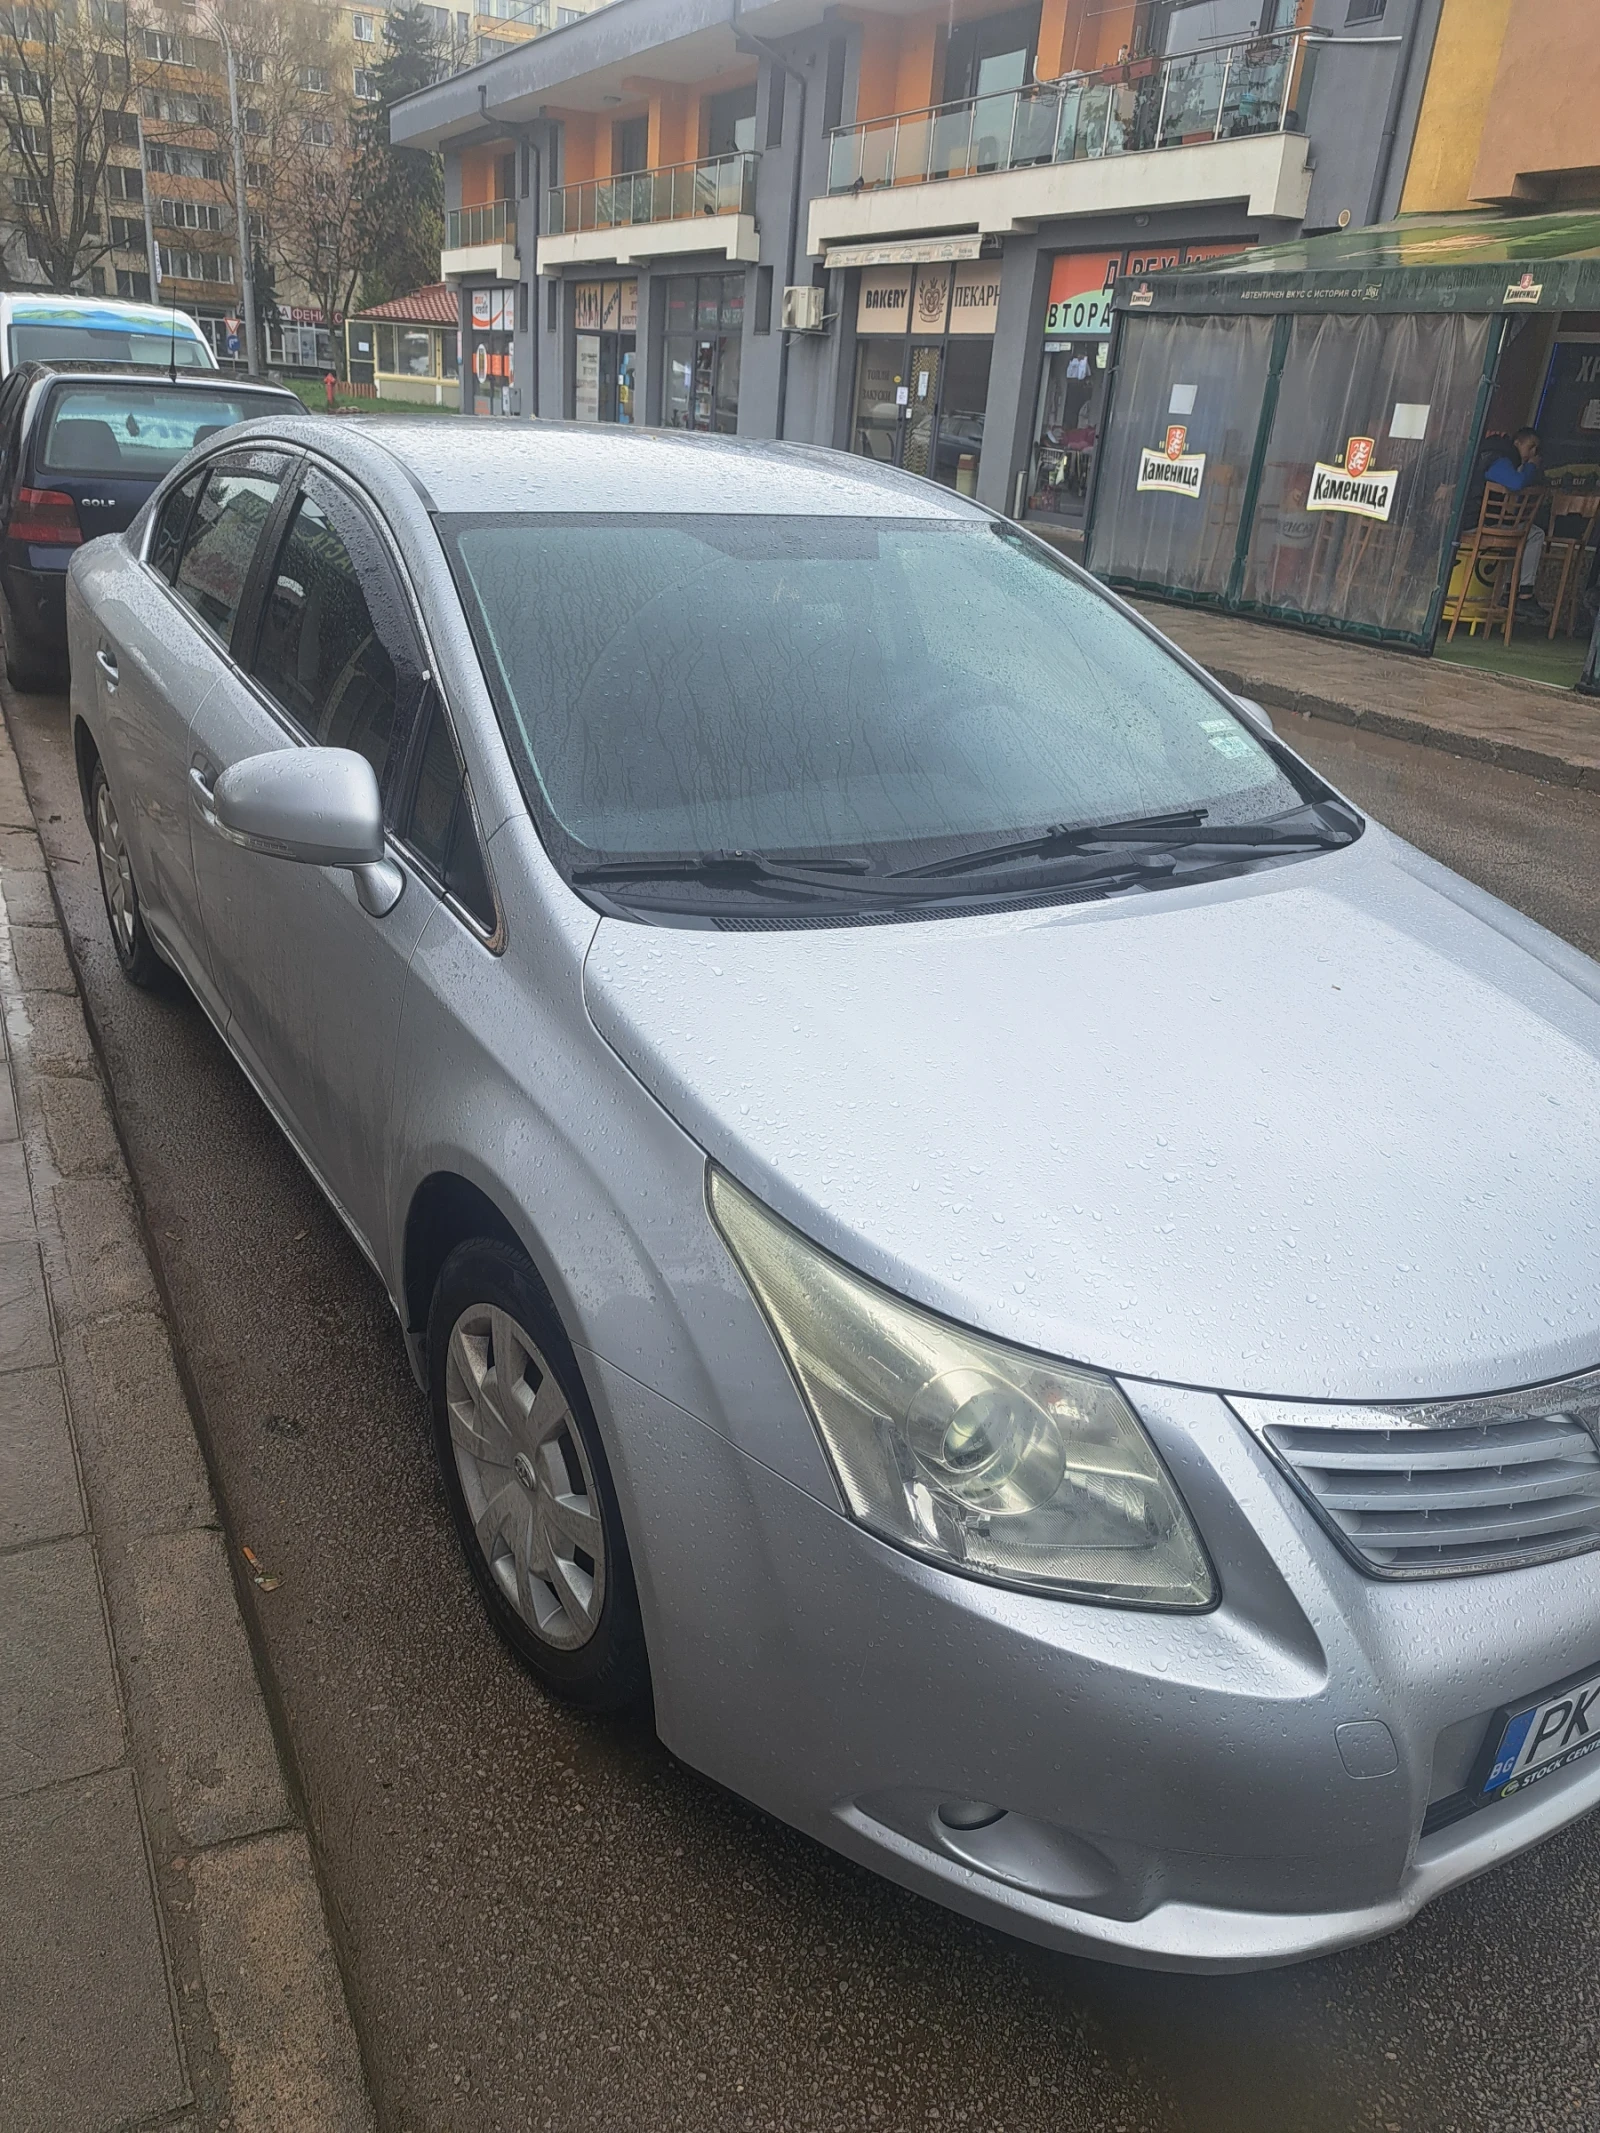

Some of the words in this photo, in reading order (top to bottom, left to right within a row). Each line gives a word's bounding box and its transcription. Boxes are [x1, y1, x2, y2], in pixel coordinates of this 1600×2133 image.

[865, 289, 908, 309] BAKERY
[1240, 290, 1284, 299] АВТЕНТИЧЕН
[1285, 289, 1305, 299] ВКУС
[1306, 290, 1313, 298] С
[1314, 289, 1349, 298] ИСТОРИЯ
[1351, 289, 1362, 297] ОТ
[292, 308, 343, 324] ФЕНИС
[1048, 302, 1111, 328] ВТОРА
[1142, 457, 1199, 488] Каменица
[81, 498, 116, 507] GOLF
[1313, 472, 1388, 509] Каменица
[1489, 1756, 1516, 1780] BG
[1521, 1757, 1564, 1788] STOCK
